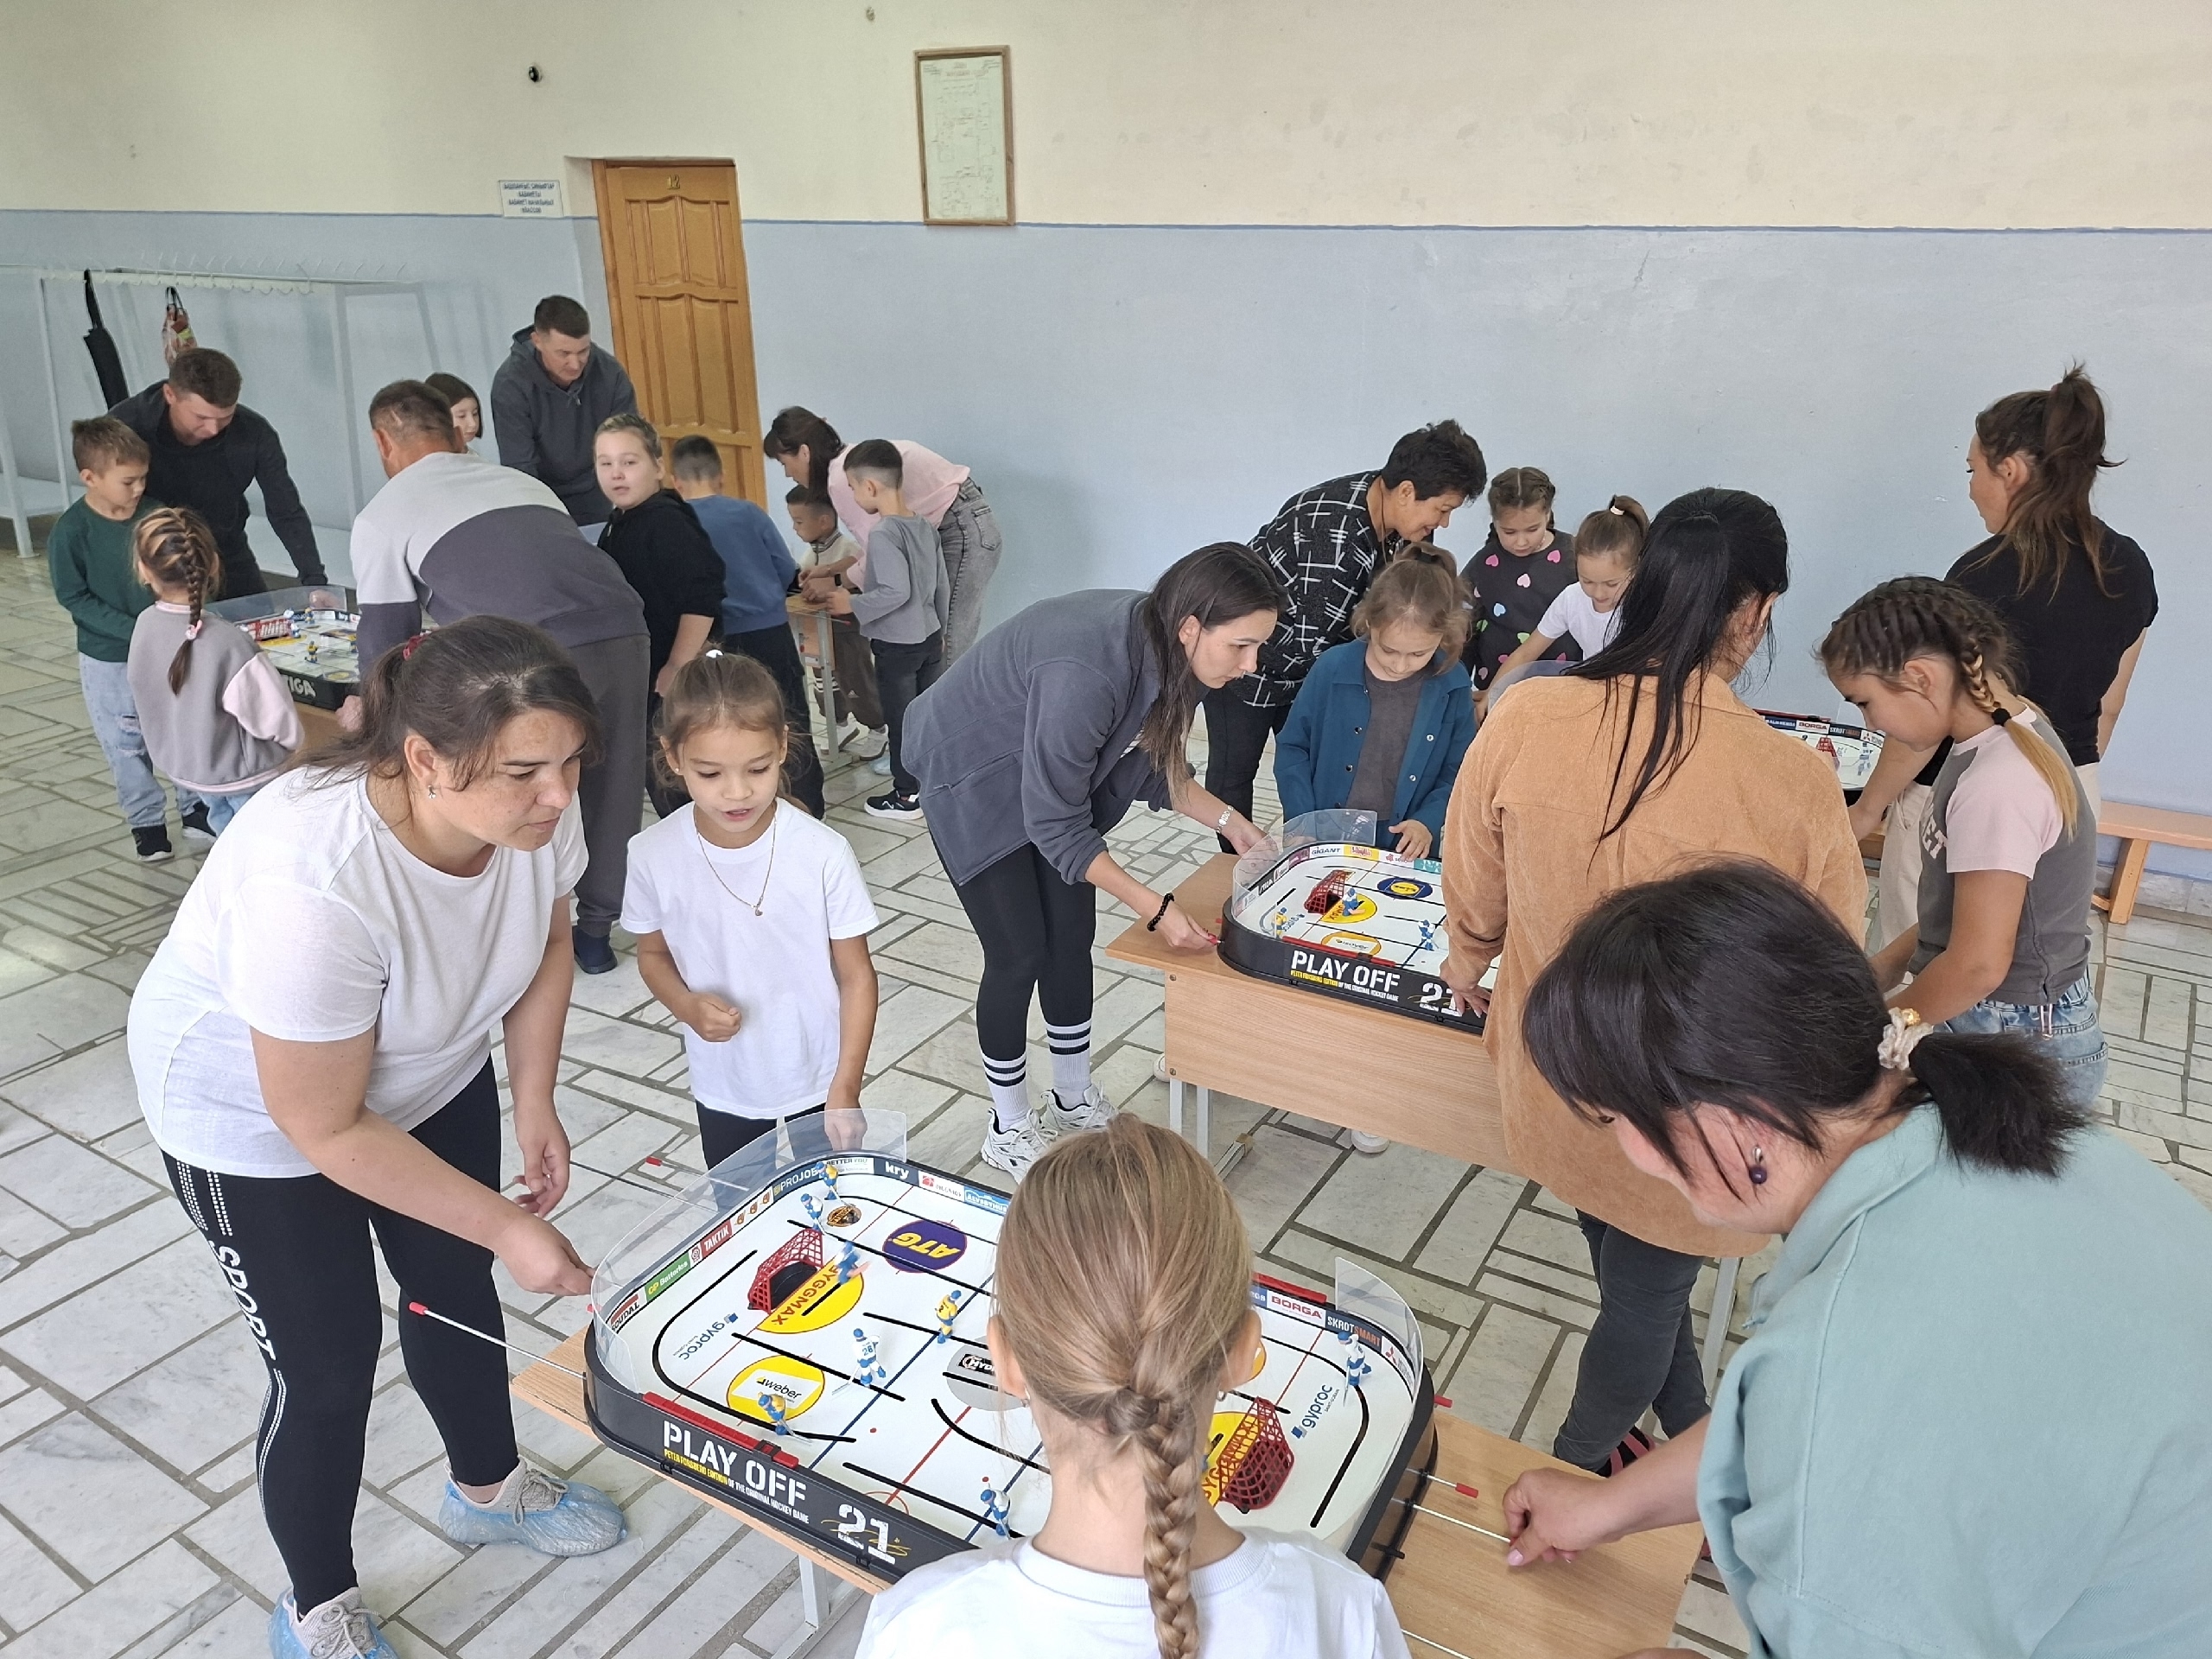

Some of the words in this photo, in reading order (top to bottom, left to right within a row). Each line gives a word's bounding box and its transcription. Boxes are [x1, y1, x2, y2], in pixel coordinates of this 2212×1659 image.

[1798, 721, 1827, 730] BORGA
[1312, 847, 1341, 855] GIGANT
[1291, 950, 1350, 980] PLAY
[1353, 965, 1401, 993] OFF
[885, 1160, 910, 1179] kry
[703, 1224, 729, 1250] TAKTIK
[892, 1232, 962, 1258] ATG
[648, 1281, 660, 1294] GP
[659, 1261, 689, 1287] Batteries
[208, 1240, 276, 1361] SPORT
[611, 1301, 640, 1332] SOUDAL
[1271, 1295, 1323, 1320] BORGA
[678, 1320, 726, 1361] gyproc
[765, 1378, 803, 1400] weber
[1301, 1384, 1333, 1428] gyproc
[664, 1421, 738, 1477] PLAY
[746, 1459, 807, 1507] OFF
[664, 1448, 681, 1463] PETER
[707, 1468, 728, 1484] EDITION
[728, 1478, 735, 1489] OF
[735, 1481, 747, 1494] THE
[771, 1497, 792, 1516] HOCKEY
[792, 1509, 810, 1524] GAME
[838, 1503, 896, 1565] 21
